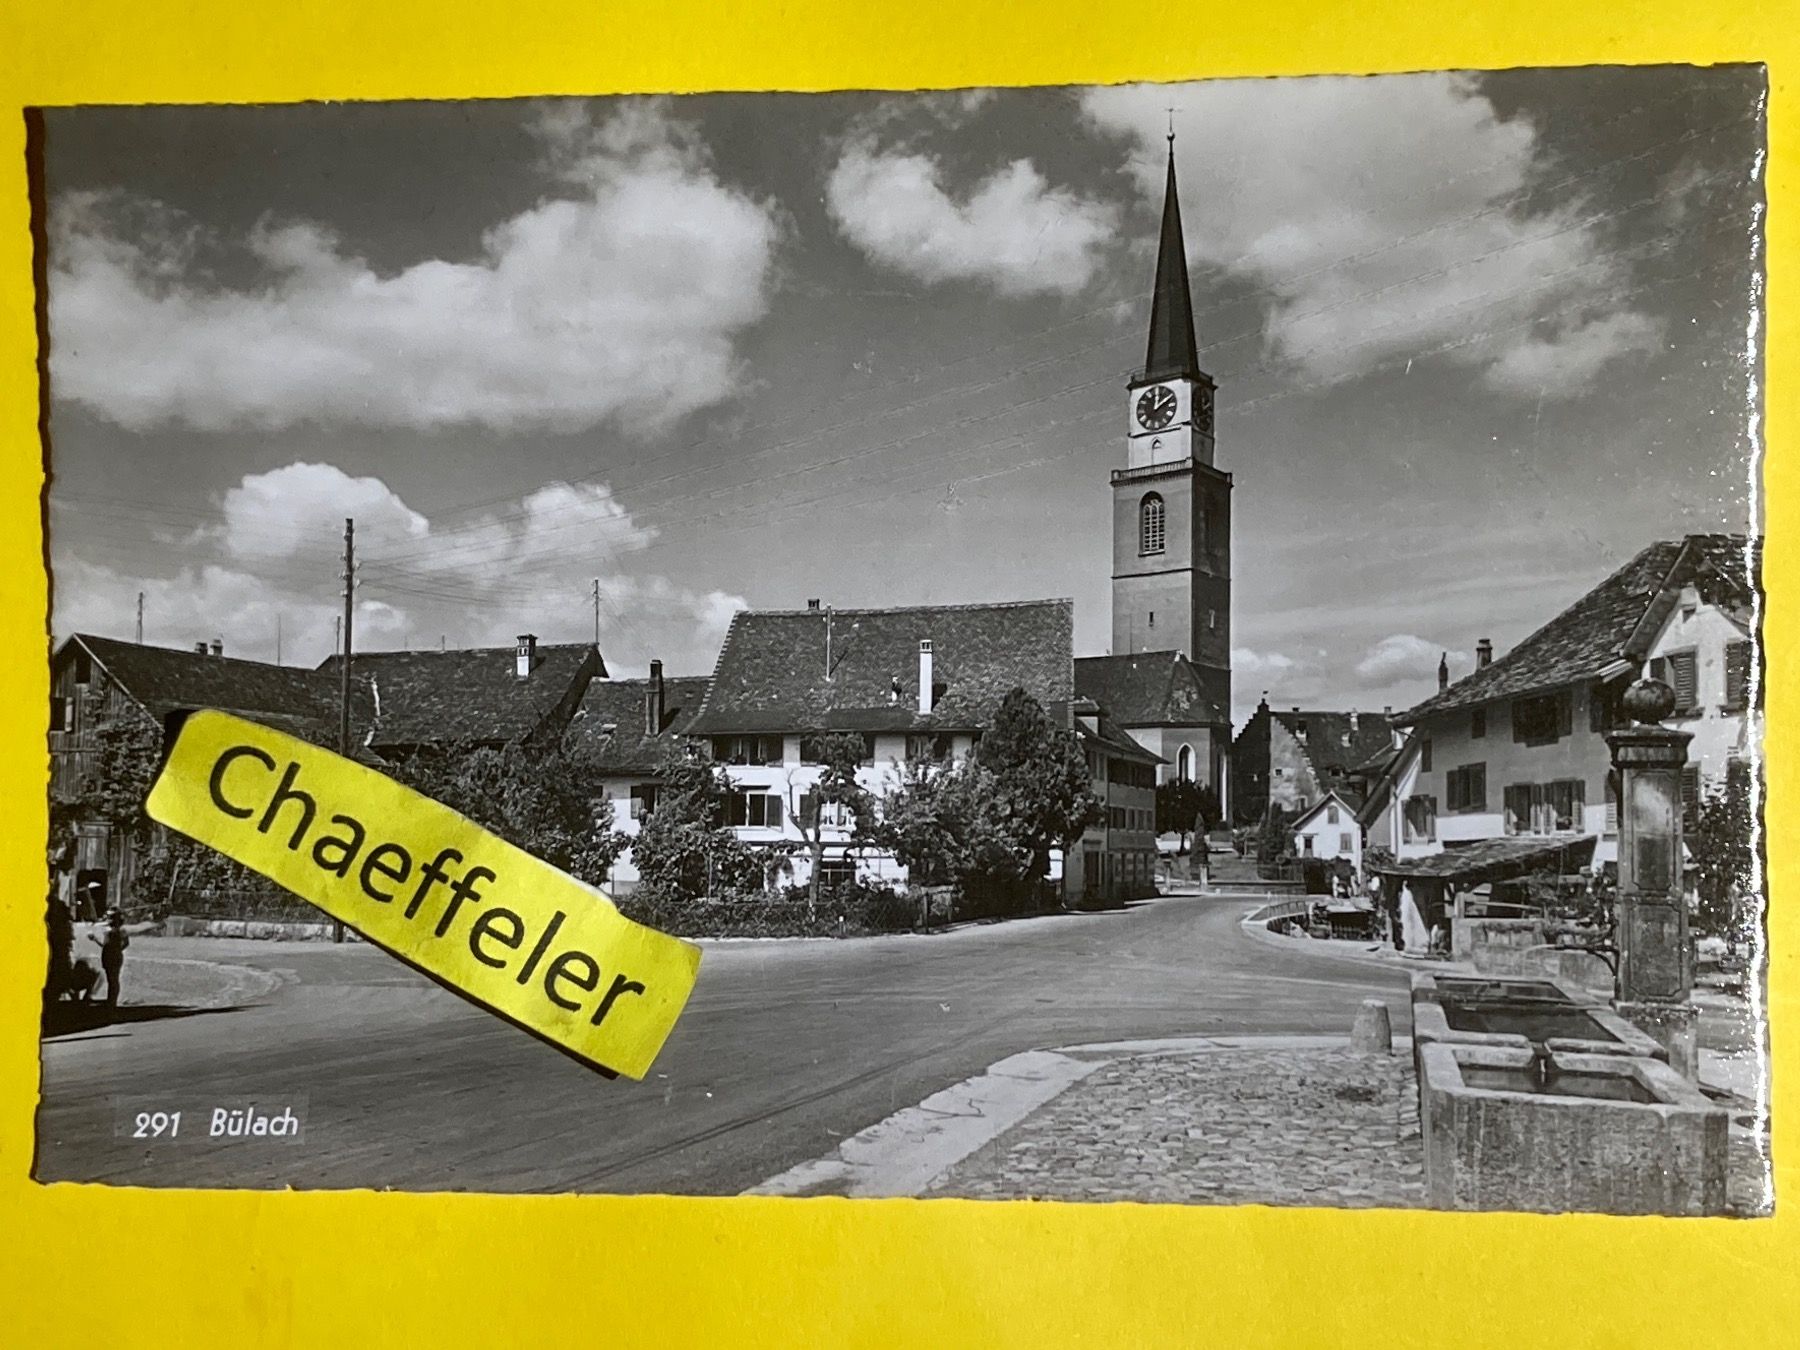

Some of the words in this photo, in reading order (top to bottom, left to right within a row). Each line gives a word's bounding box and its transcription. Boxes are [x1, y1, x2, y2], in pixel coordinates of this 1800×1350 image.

[209, 745, 646, 1027] Chaeffeler
[132, 1111, 182, 1138] 291
[209, 1106, 299, 1137] Bülach
